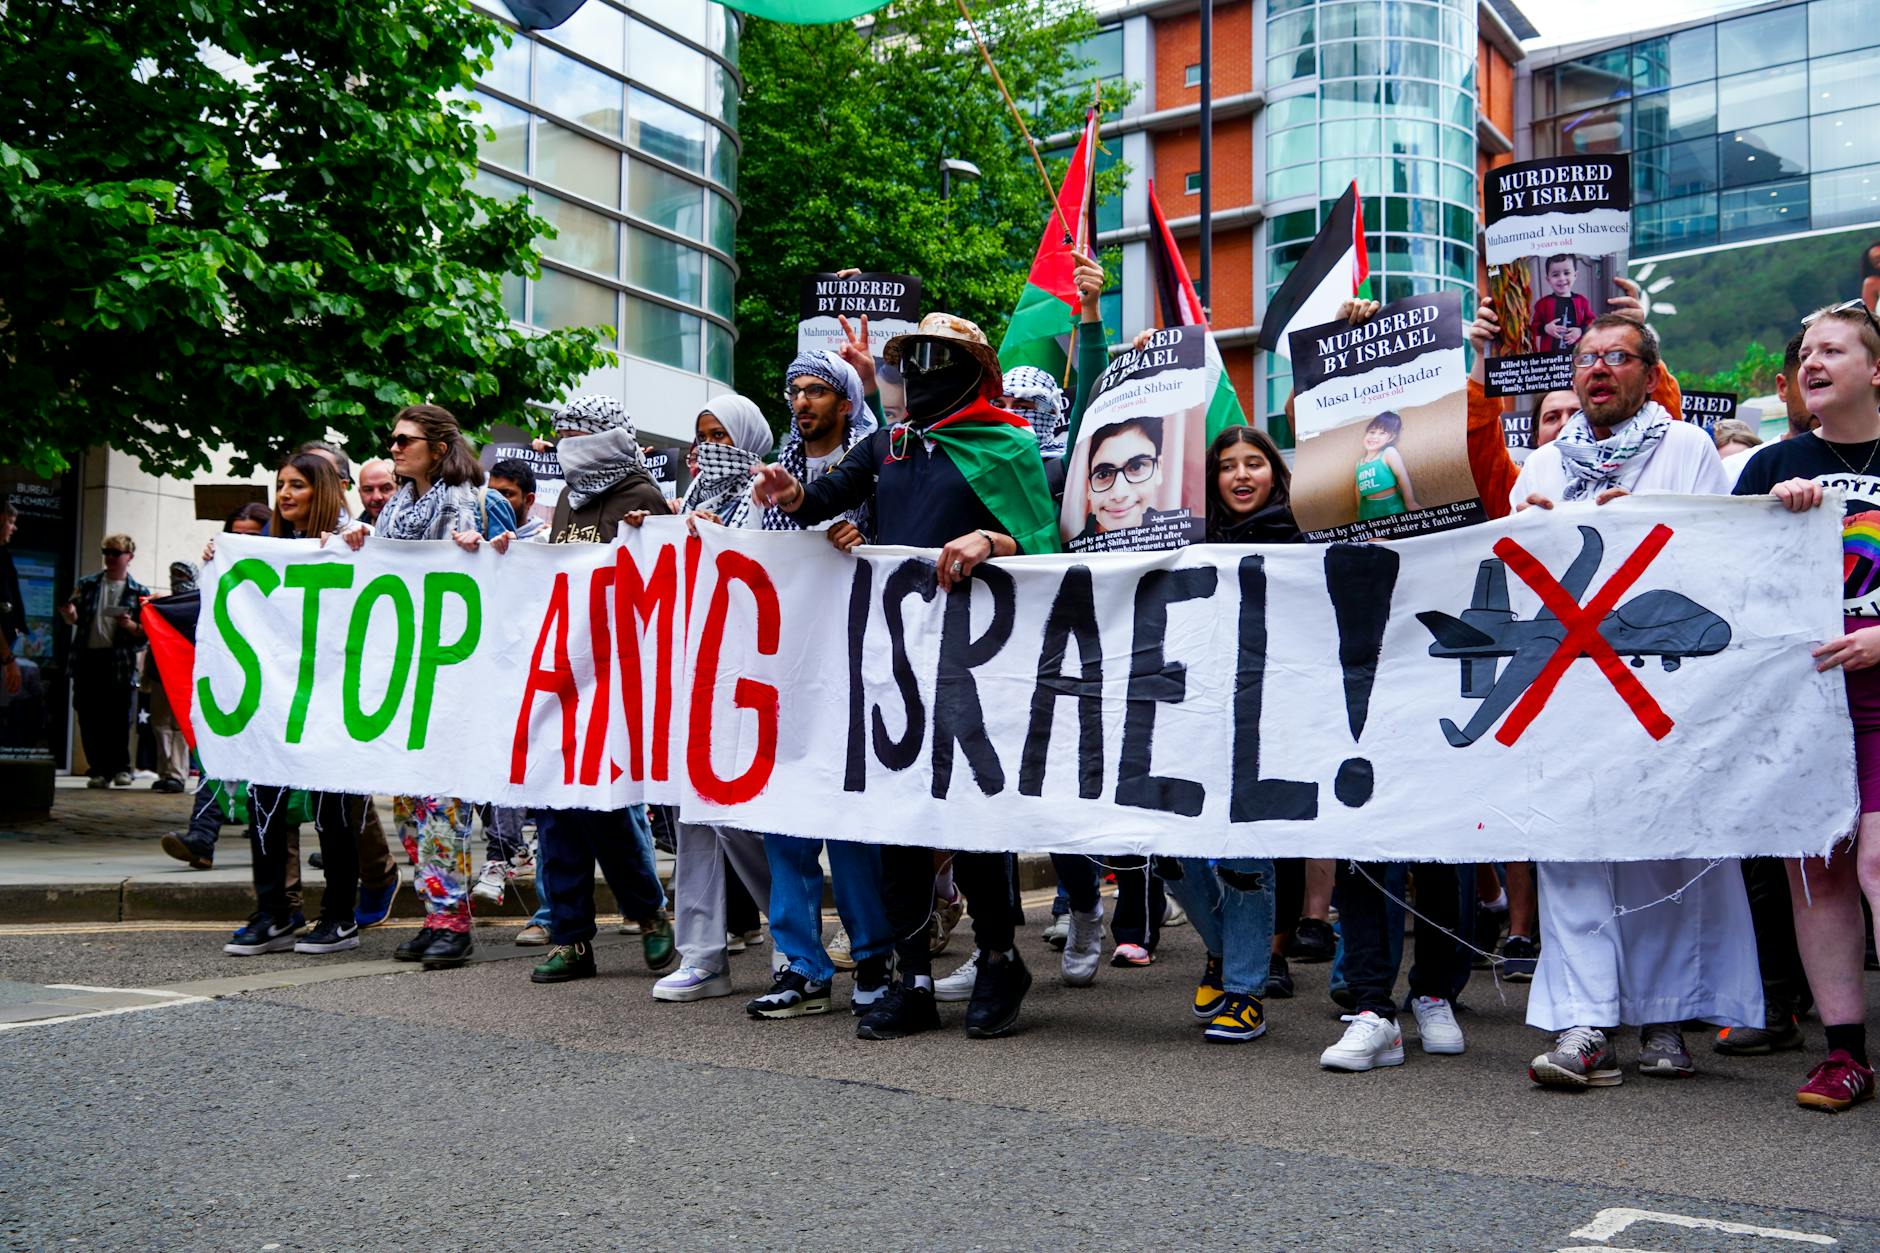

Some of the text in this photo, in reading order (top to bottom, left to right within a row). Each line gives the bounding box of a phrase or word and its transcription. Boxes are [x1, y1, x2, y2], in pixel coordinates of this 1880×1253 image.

[1499, 164, 1613, 193] MURDERED
[1502, 184, 1609, 212] BY ISRAEL
[1487, 227, 1544, 247] Muhammad
[1549, 224, 1575, 236] Abu
[1537, 240, 1558, 250] years
[1559, 238, 1573, 246] old
[816, 281, 905, 297] MURDERED
[818, 297, 900, 313] BY ISRAEL
[1316, 305, 1439, 356] MURDERED
[1323, 326, 1436, 375] BY ISRAEL
[1501, 360, 1520, 370] Killed
[1521, 359, 1528, 370] by
[1529, 358, 1540, 366] the
[1540, 354, 1563, 365] israeli
[1489, 364, 1570, 379] targeting his home along
[1144, 380, 1183, 396] Shbair
[1316, 366, 1442, 410] Masa Loai Khadar
[1491, 377, 1516, 385] brother
[1525, 382, 1549, 391] leaving
[1550, 380, 1568, 388] their
[1367, 391, 1390, 404] years
[1391, 385, 1404, 395] old
[1508, 432, 1531, 447] BY
[16, 483, 54, 496] BUREAU
[1308, 501, 1477, 541] Killed by the israeli attacks on Gaza
[1350, 530, 1373, 542] with
[1374, 528, 1391, 537] her
[1393, 523, 1419, 533] sister
[1421, 519, 1431, 529] &
[1431, 514, 1467, 527] father.
[1069, 537, 1086, 549] Killed
[1086, 536, 1095, 545] by
[1104, 528, 1126, 539] israeli
[1127, 527, 1151, 536] sniper
[1151, 524, 1167, 532] shot
[1180, 520, 1192, 529] his
[1095, 541, 1106, 549] the
[1131, 532, 1163, 543] Hospital
[1163, 531, 1183, 540] after
[1166, 540, 1176, 548] on
[1177, 538, 1190, 546] the
[197, 558, 482, 751] STOP
